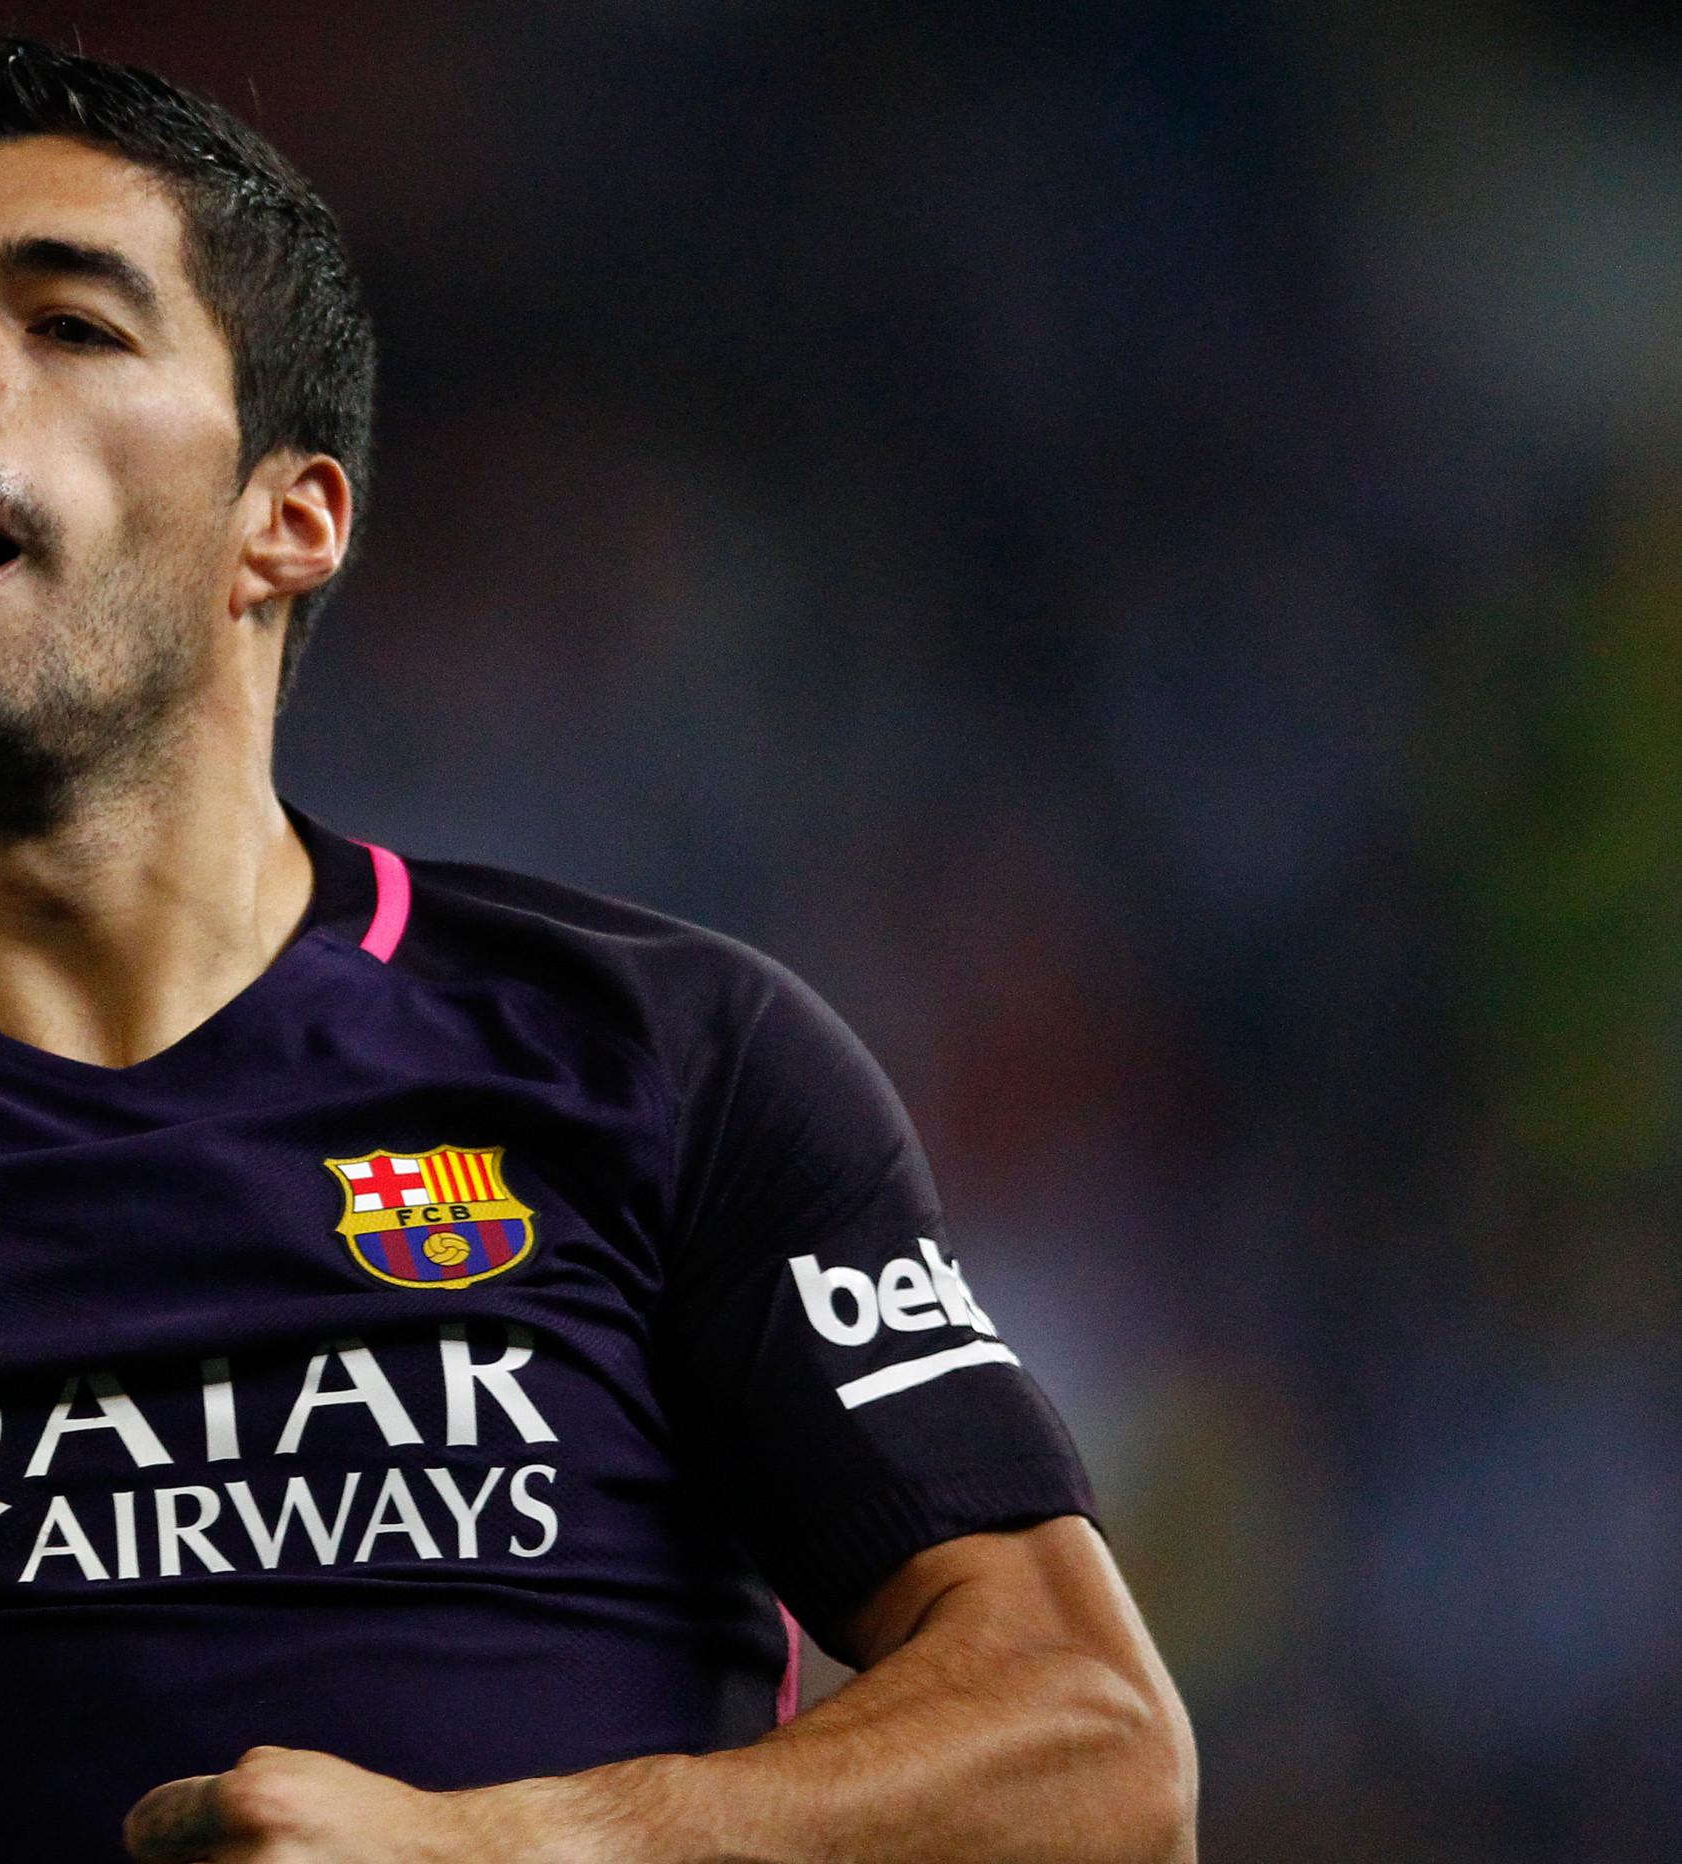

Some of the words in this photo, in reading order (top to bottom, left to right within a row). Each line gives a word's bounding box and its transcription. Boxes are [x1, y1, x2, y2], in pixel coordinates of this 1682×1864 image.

[397, 1205, 471, 1226] FCB
[788, 1237, 999, 1347] bek
[18, 1464, 558, 1582] AIRWAYS
